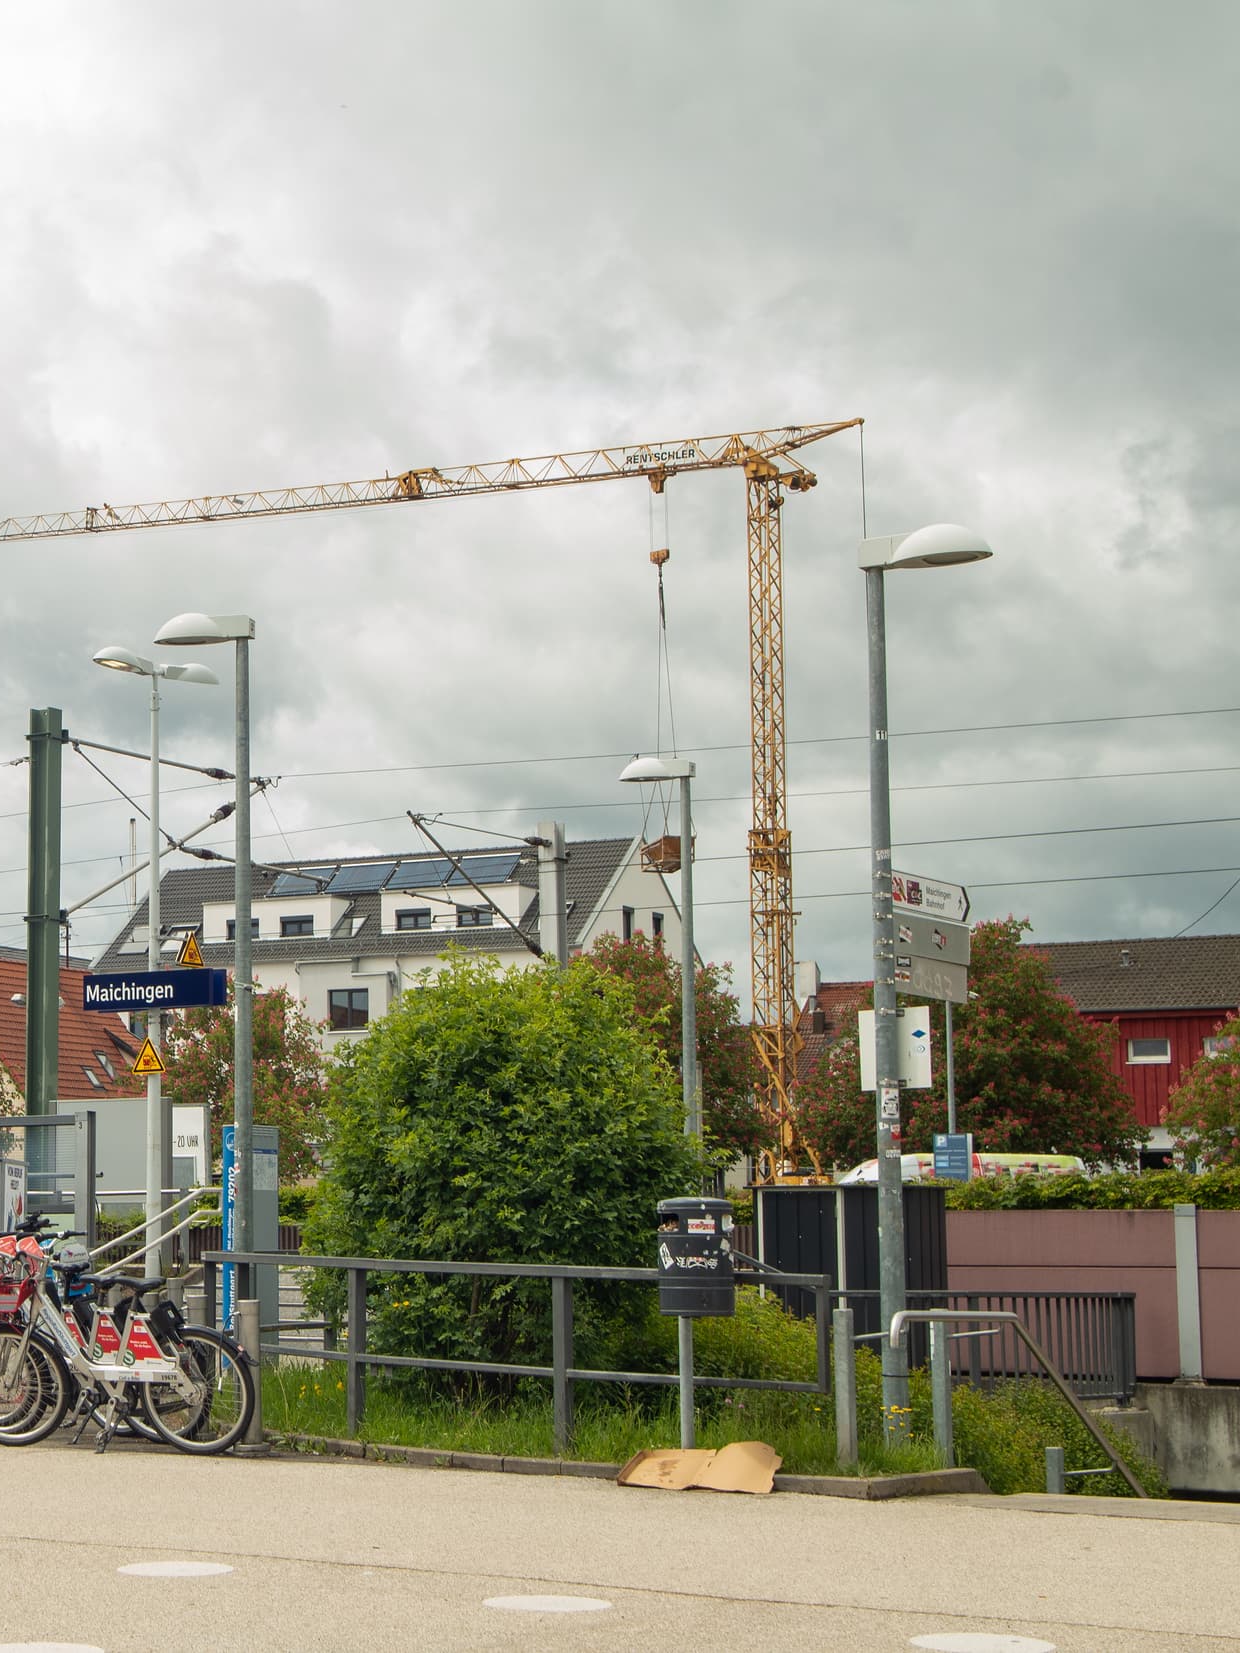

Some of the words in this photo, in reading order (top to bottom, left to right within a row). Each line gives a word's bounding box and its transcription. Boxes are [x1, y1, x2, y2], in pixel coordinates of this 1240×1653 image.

[626, 448, 695, 465] RENTSCHLER
[85, 981, 174, 1003] Maichingen
[186, 1135, 199, 1147] UHR
